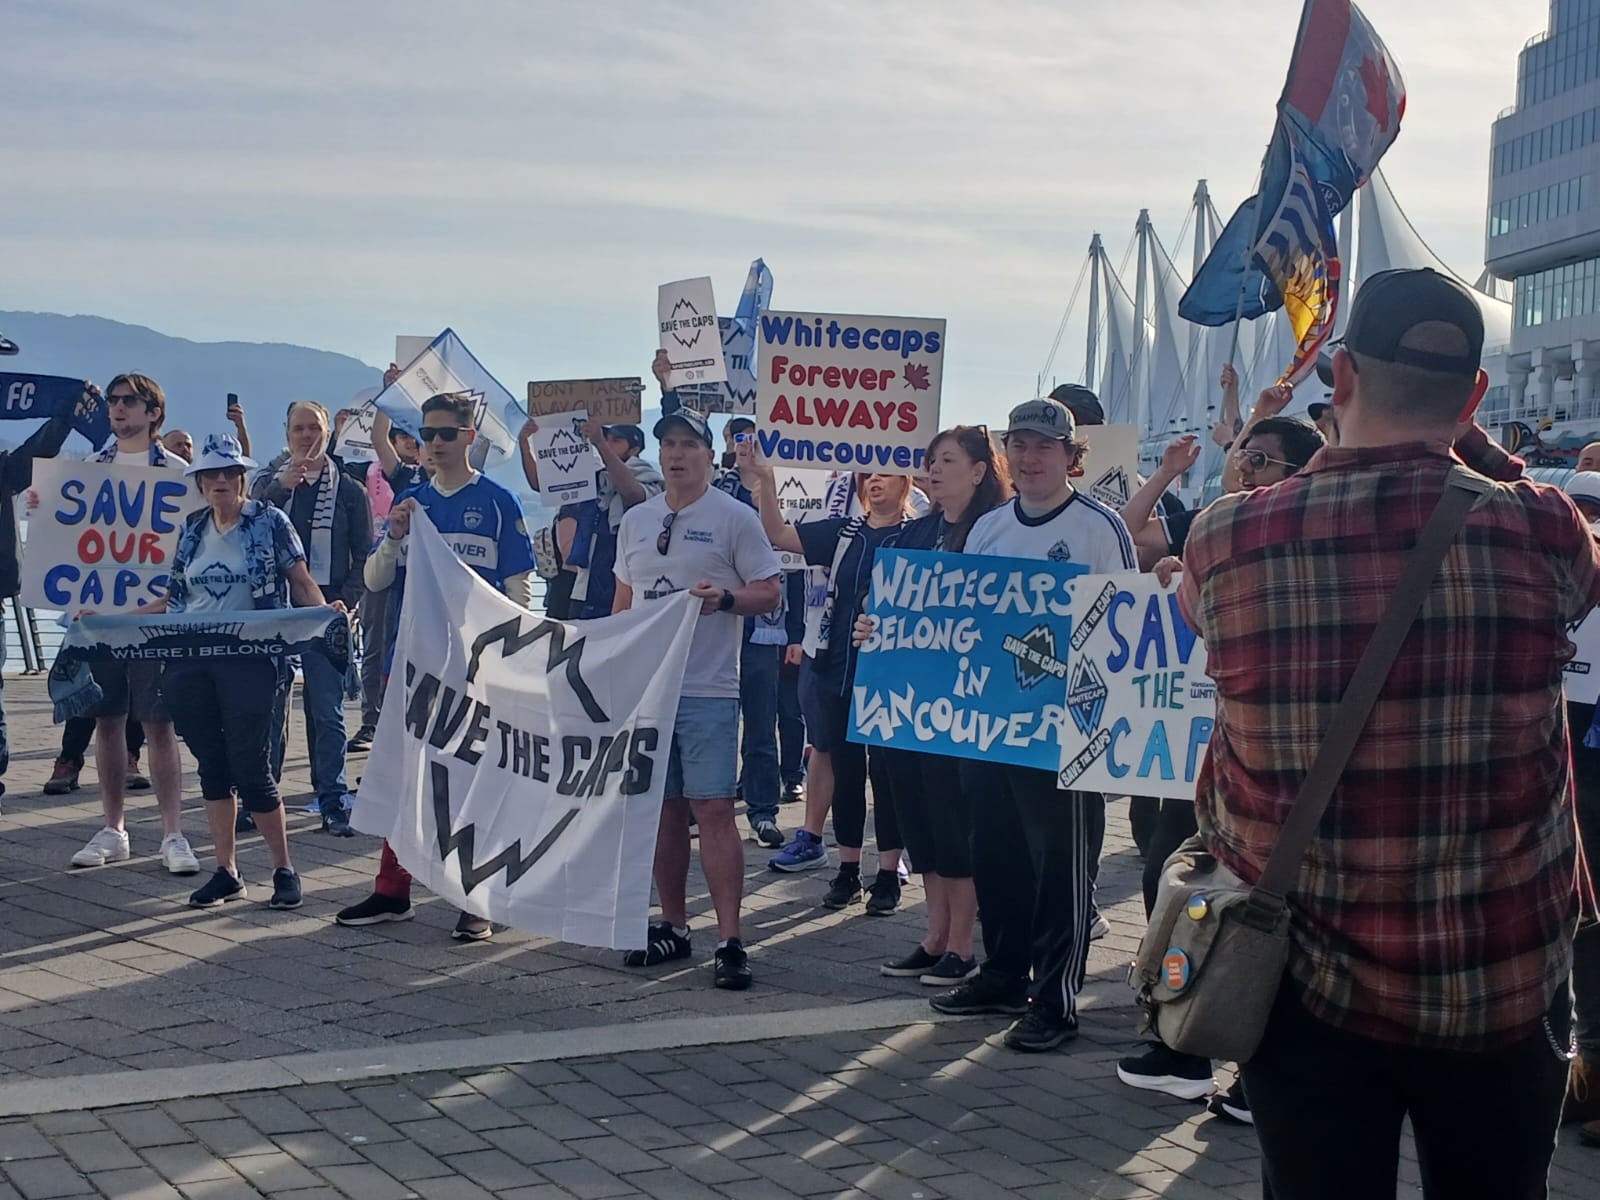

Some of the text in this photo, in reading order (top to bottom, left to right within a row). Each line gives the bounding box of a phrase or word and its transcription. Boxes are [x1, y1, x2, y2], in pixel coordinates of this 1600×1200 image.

[661, 315, 714, 332] SAVE THE CAPS
[761, 315, 940, 358] Whitecaps
[532, 383, 574, 398] DONT
[771, 355, 896, 391] Forever
[6, 381, 36, 411] FC
[769, 395, 919, 433] ALWAYS
[538, 443, 590, 459] SAVE THE CAPS
[757, 429, 926, 469] Vancouver
[55, 479, 188, 533] SAVE
[786, 499, 797, 509] THE
[799, 498, 822, 509] CAPS
[78, 529, 165, 564] OUR
[43, 564, 170, 606] CAPS
[224, 574, 247, 584] CAPS
[860, 614, 983, 653] BELONG
[1071, 582, 1116, 649] SAVE THE CAPS
[1107, 590, 1201, 673] SAV
[112, 644, 283, 659] WHERE I BELONG
[1003, 635, 1067, 678] SAVE THE CAPS
[1068, 688, 1106, 704] WHITECAPS
[1132, 671, 1185, 709] THE
[853, 682, 1065, 752] VANCOUVER
[496, 720, 550, 783] THE
[556, 727, 659, 796] CAPS
[1060, 730, 1111, 786] SAVE THE CAPS
[1106, 716, 1214, 783] CAP
